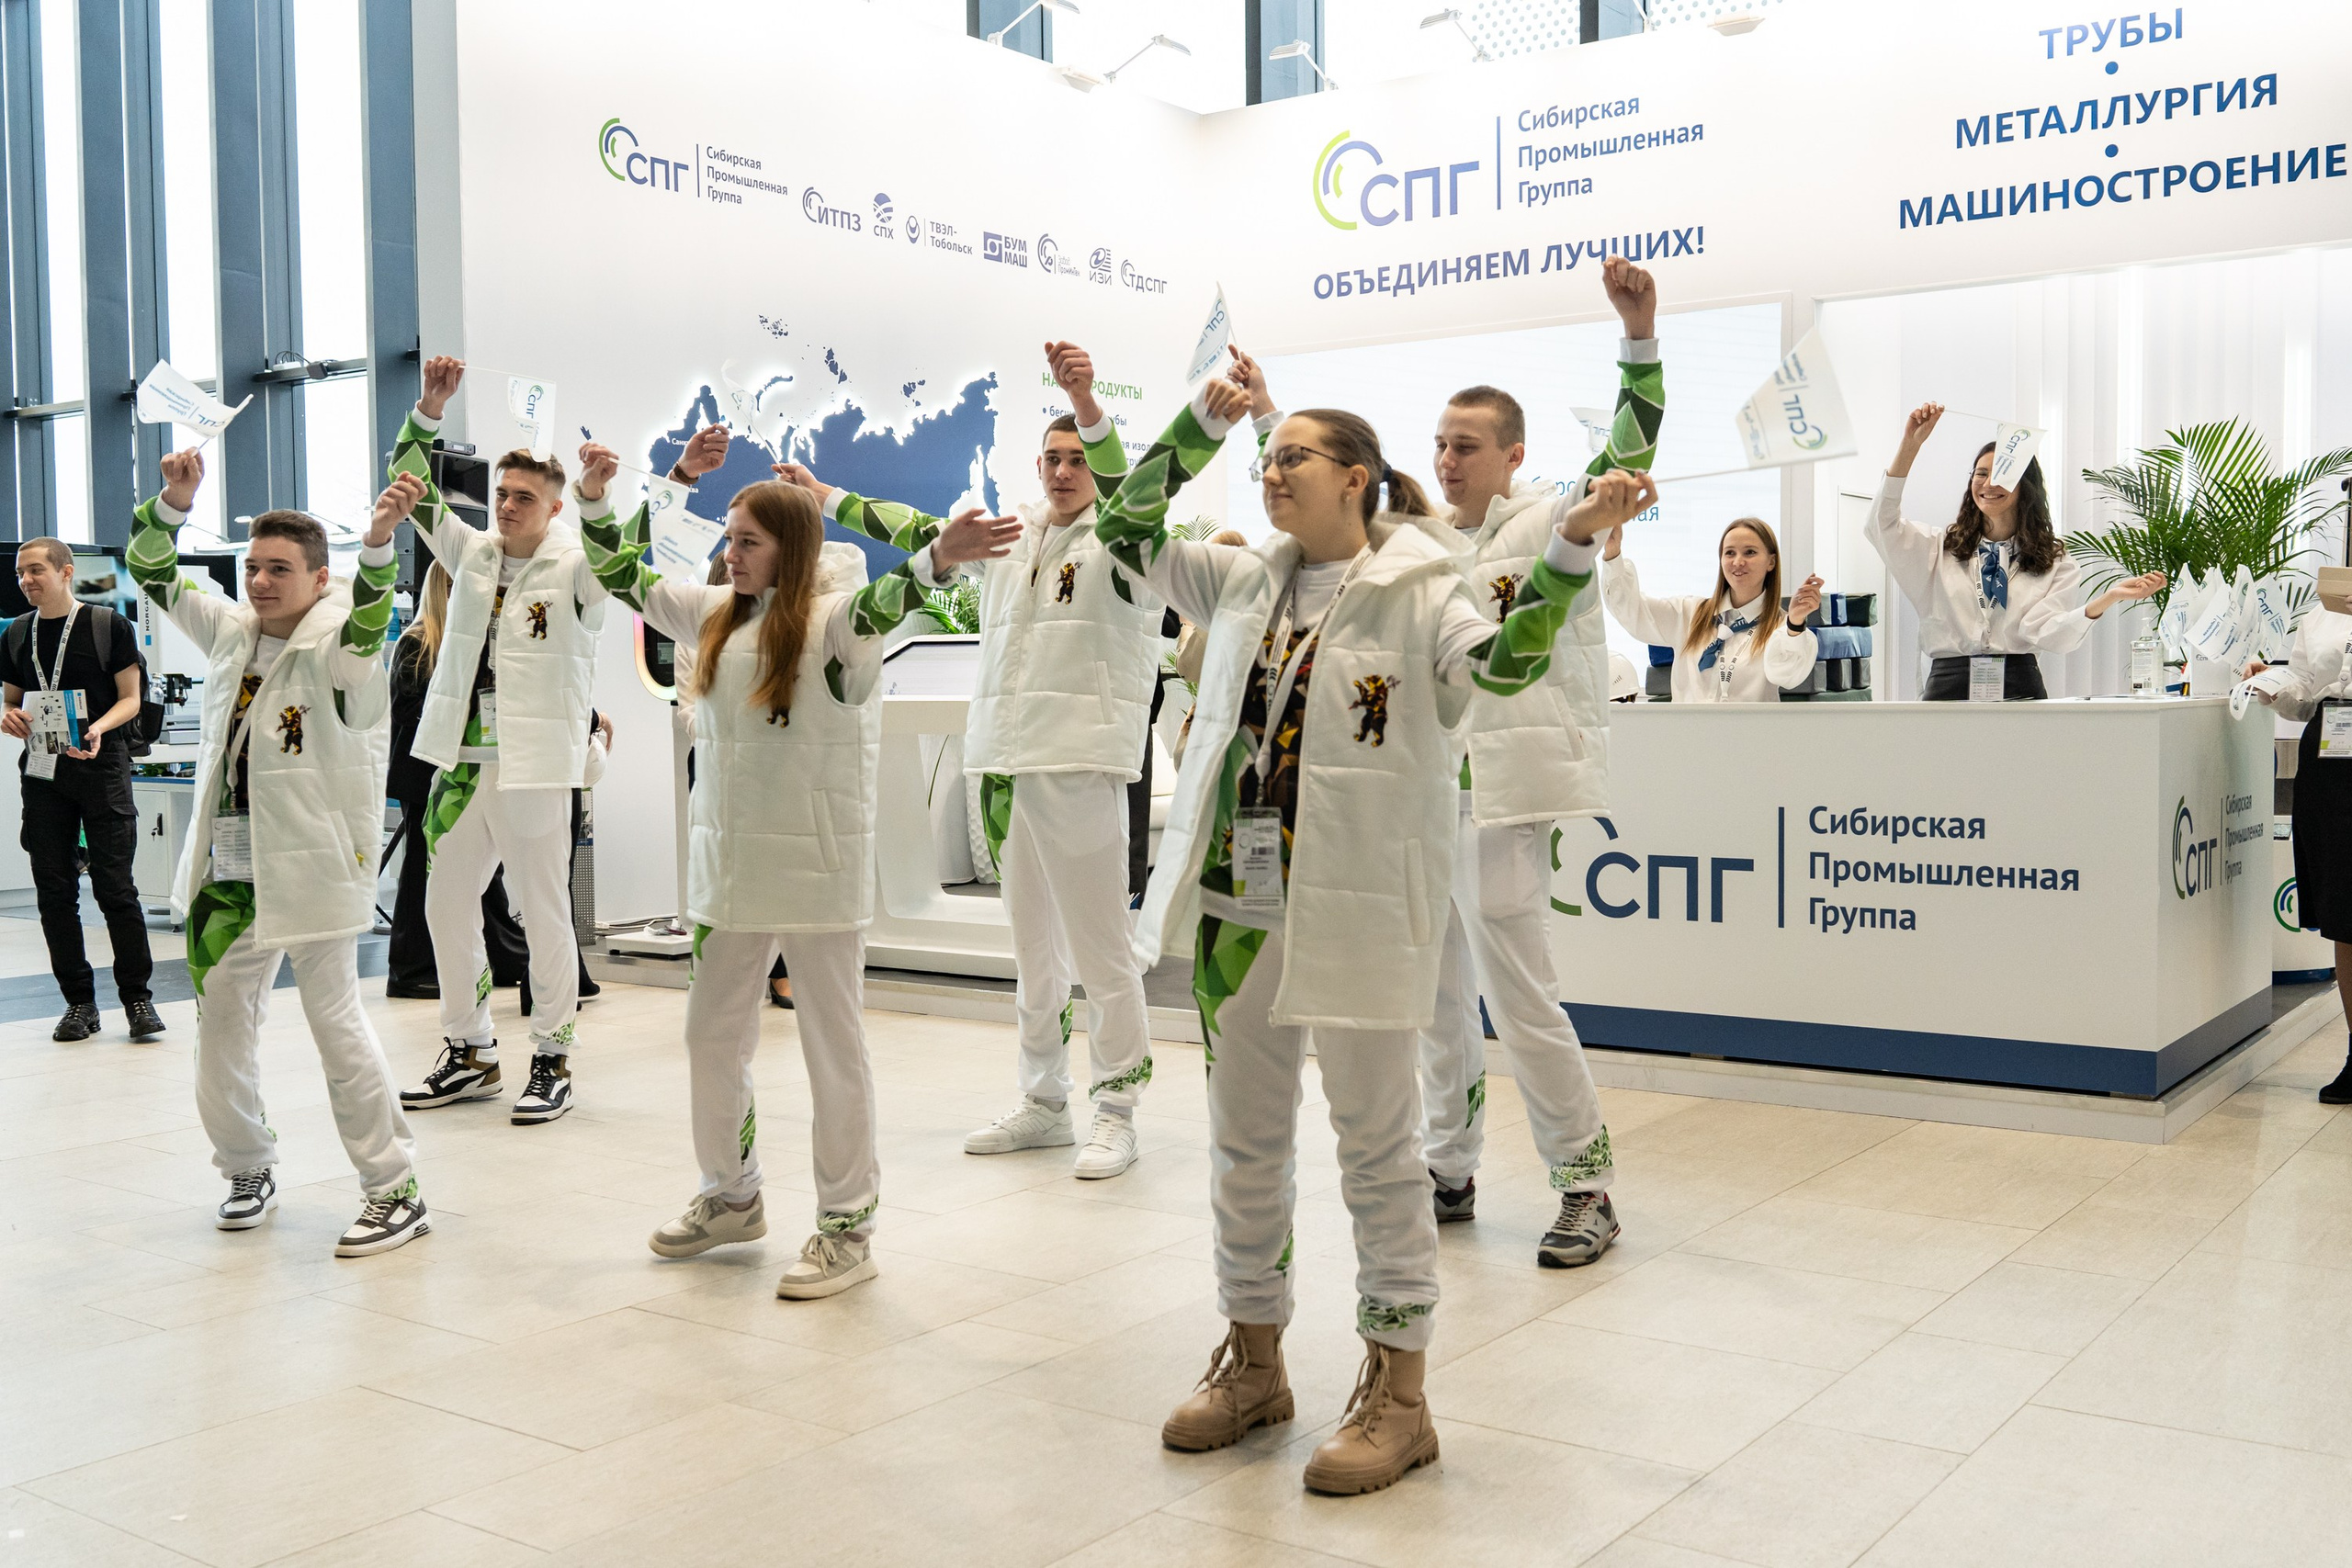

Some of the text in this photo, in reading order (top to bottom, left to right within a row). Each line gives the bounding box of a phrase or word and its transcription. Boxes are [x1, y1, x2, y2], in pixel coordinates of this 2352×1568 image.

[2039, 7, 2183, 60] ТРУБЫ
[1518, 96, 1640, 132] Сибирская
[1956, 73, 2278, 149] МЕТАЛЛУРГИЯ
[707, 146, 762, 170] Сибирская
[1518, 123, 1704, 171] Промышленная
[626, 152, 689, 193] СПГ
[707, 166, 787, 196] Промышленная
[1899, 143, 2347, 229] МАШИНОСТРОЕНИЕ
[707, 186, 742, 205] Группа
[1360, 161, 1480, 227] СПГ
[1519, 176, 1593, 208] Группа
[874, 225, 894, 240] СПХ
[930, 221, 957, 237] ТВЭЛ-
[930, 235, 973, 255] Тобольск
[1004, 236, 1027, 253] БУМ
[1004, 252, 1027, 268] МАШ
[1313, 226, 1705, 299] ОБЪЕДИНЯЕМ ЛУЧШИХ!
[1091, 379, 1142, 400] РОДУКТЫ
[1809, 806, 1985, 844] Сибирская
[1809, 852, 2080, 892] Промышленная
[2186, 838, 2217, 897] СПГ
[1585, 852, 1754, 923] СПГ
[1809, 897, 1917, 934] Группа
